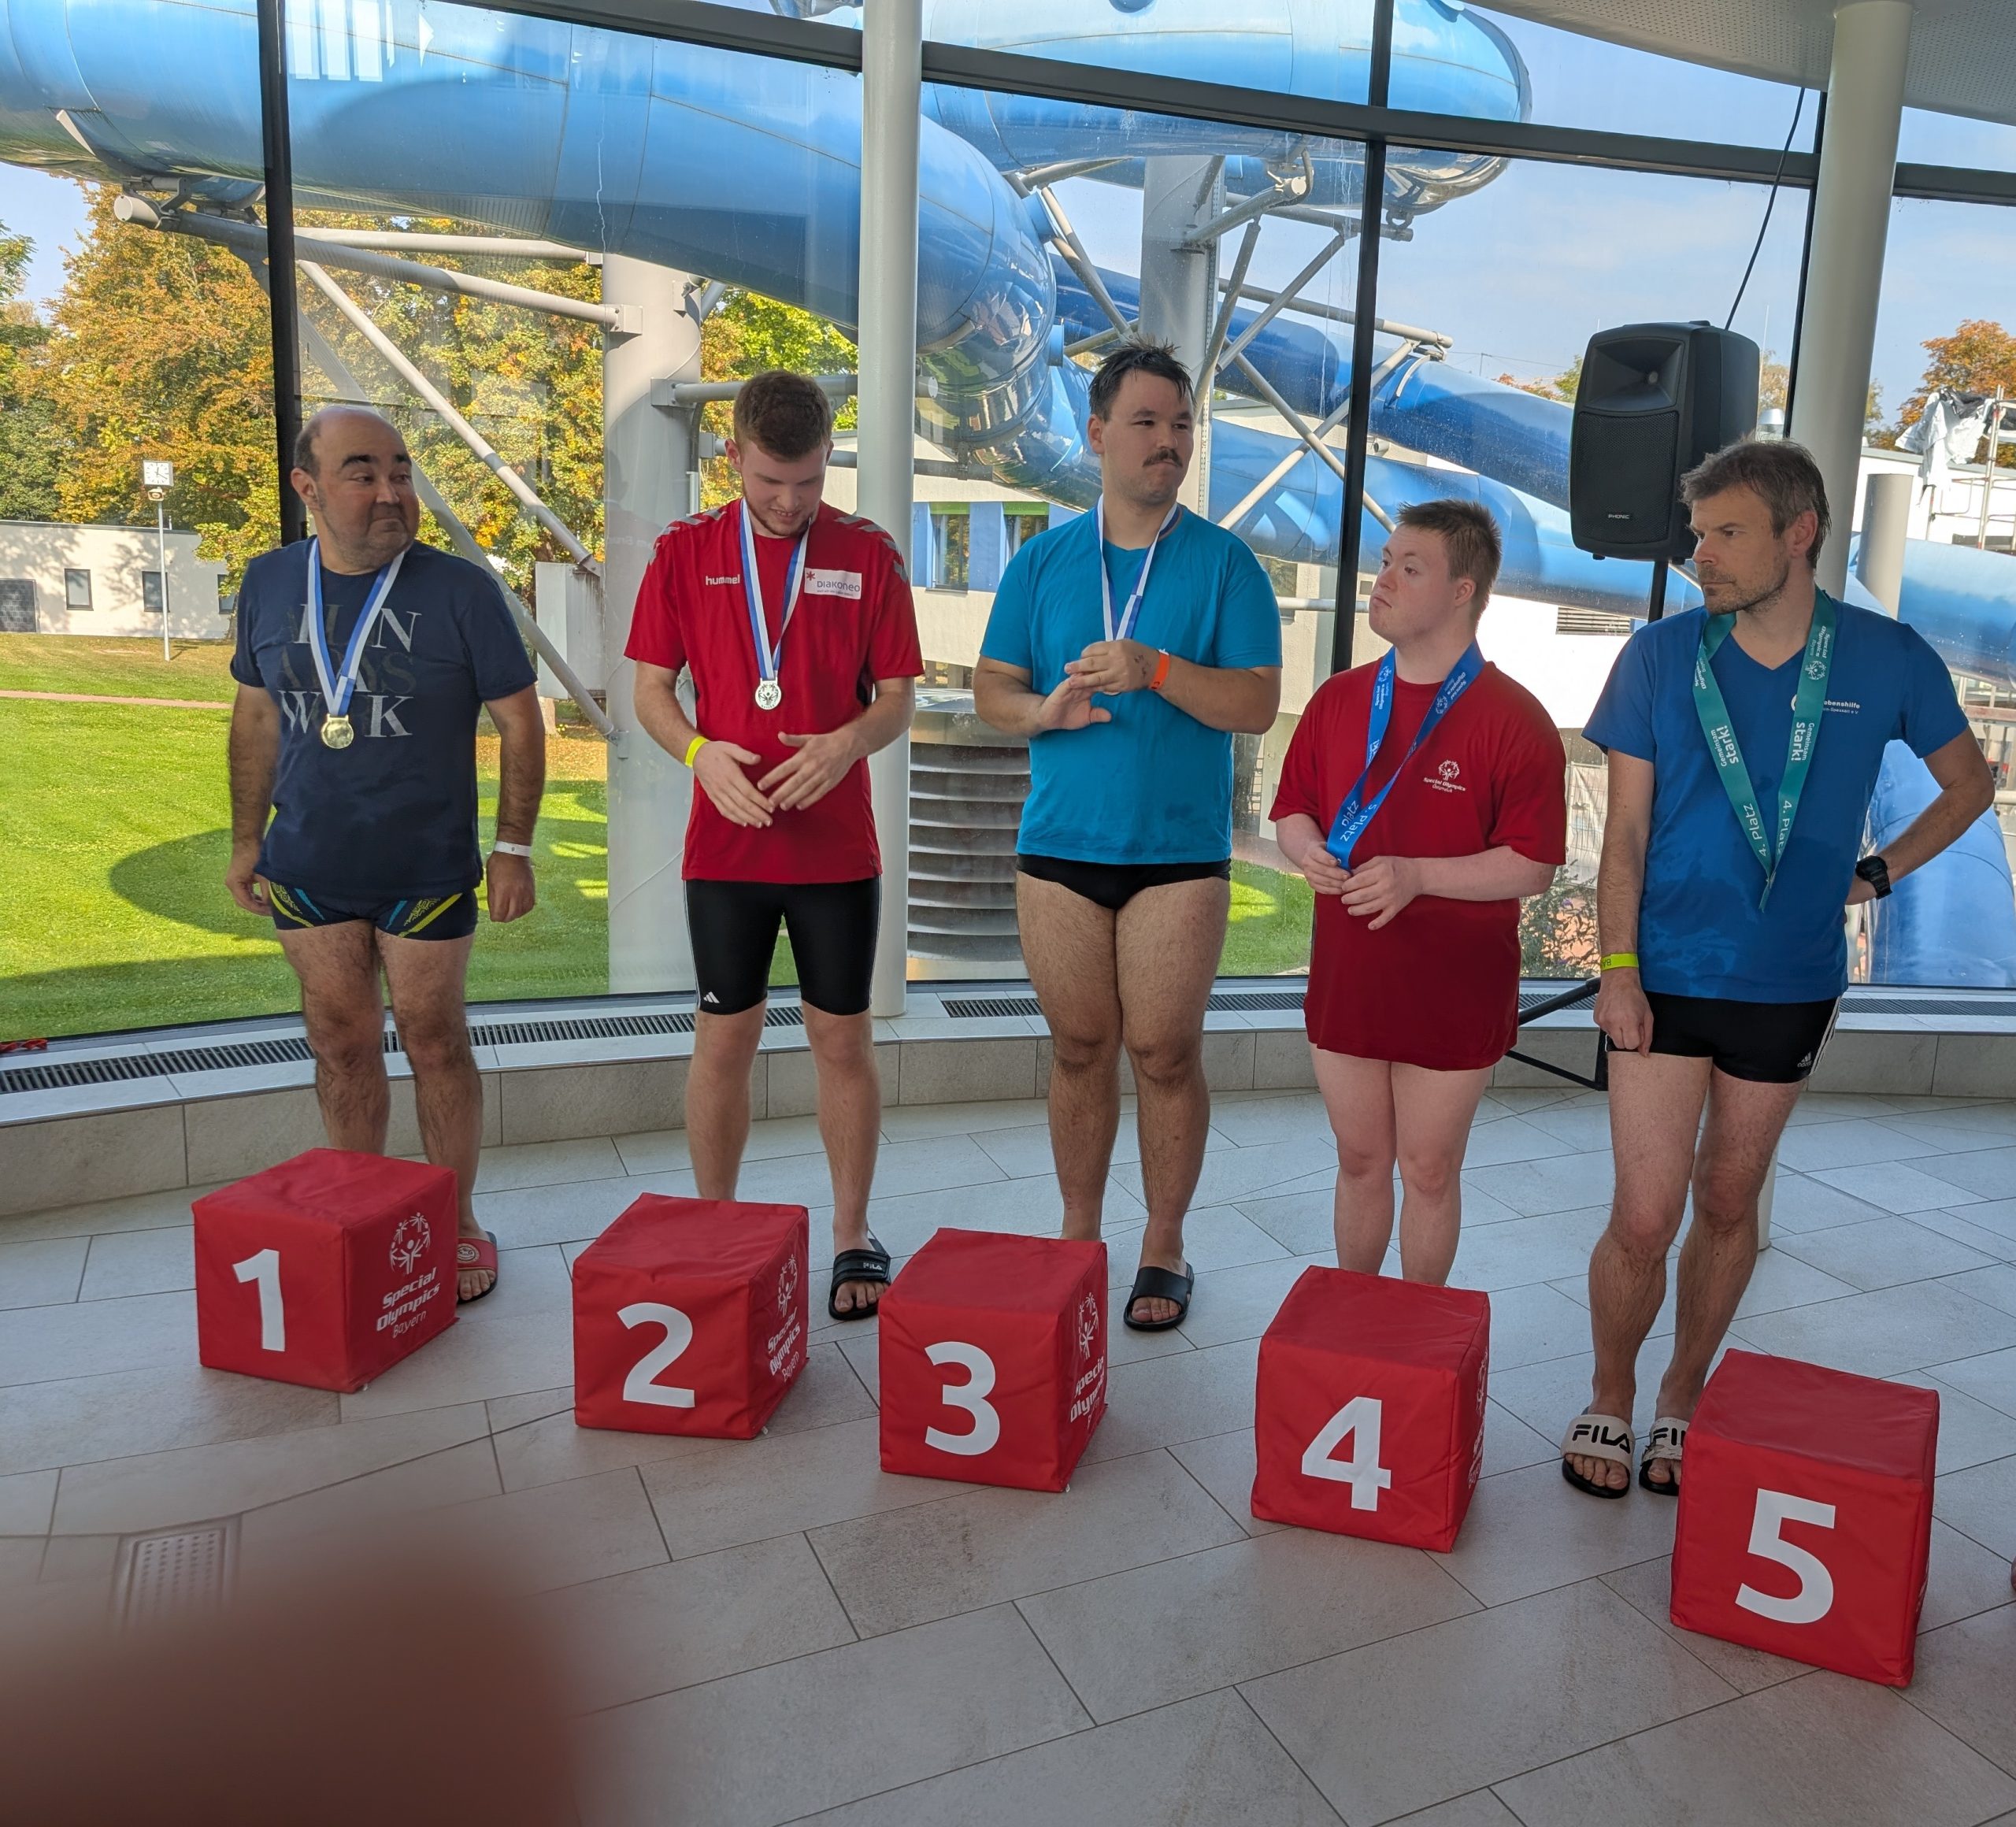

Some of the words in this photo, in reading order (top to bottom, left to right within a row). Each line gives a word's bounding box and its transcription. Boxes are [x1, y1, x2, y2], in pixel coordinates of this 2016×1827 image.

[705, 574, 740, 586] hummel
[1815, 625, 1827, 658] Olympics
[1821, 632, 1831, 659] Special
[1823, 700, 1861, 710] ebenshilfe
[1710, 729, 1728, 767] Gemeinsam
[1716, 724, 1740, 765] stark!
[1791, 721, 1806, 762] stark!
[1800, 722, 1815, 762] Gemeinsam
[1743, 802, 1763, 840] Platz
[1782, 800, 1792, 813] 4.
[1340, 815, 1368, 842] Platz
[1777, 817, 1790, 856] Platz
[1758, 843, 1767, 857] 4.
[862, 1262, 883, 1271] FILA
[232, 1247, 286, 1352] 1
[376, 1282, 441, 1332] Olympics
[382, 1266, 437, 1310] Special
[392, 1310, 427, 1339] Bayern
[768, 1306, 798, 1355] Special
[617, 1302, 696, 1409] 2
[769, 1321, 801, 1377] Olympics
[781, 1351, 800, 1383] Bayern
[924, 1341, 1001, 1456] 3
[1301, 1395, 1392, 1513] 4
[1572, 1424, 1631, 1455] FILA
[1735, 1487, 1836, 1625] 5
